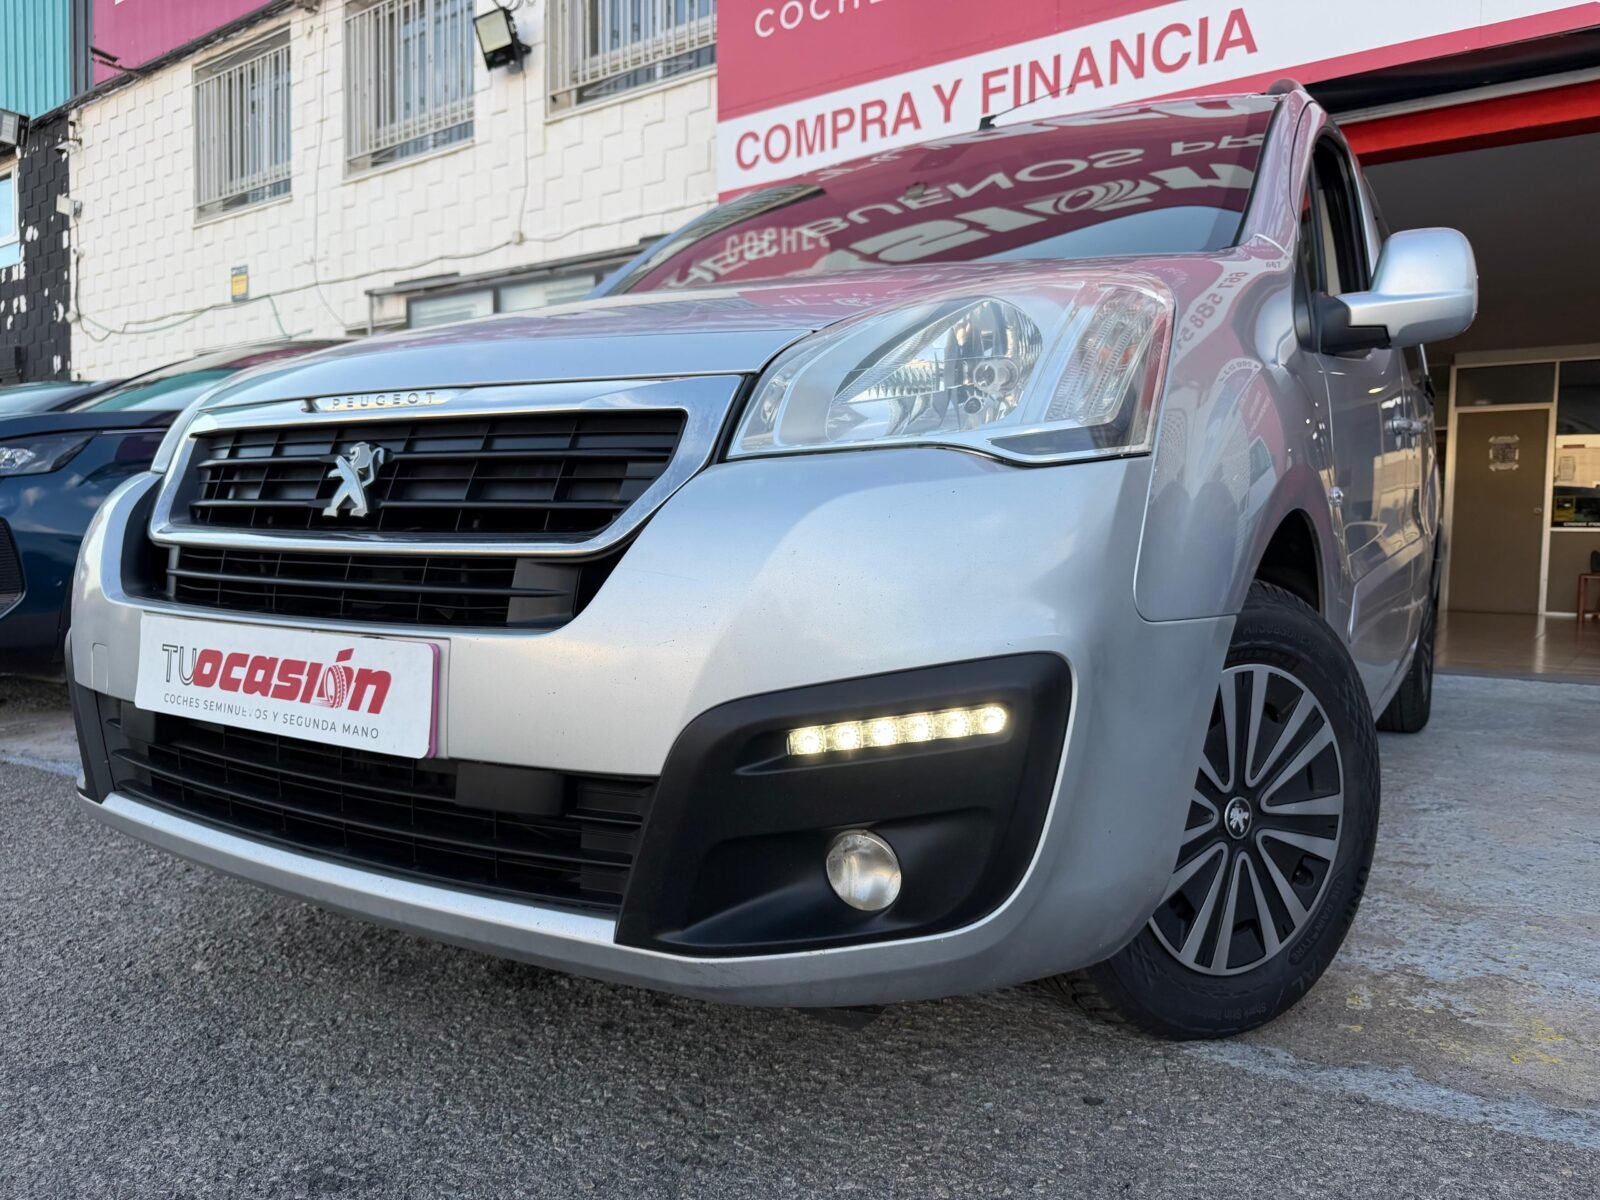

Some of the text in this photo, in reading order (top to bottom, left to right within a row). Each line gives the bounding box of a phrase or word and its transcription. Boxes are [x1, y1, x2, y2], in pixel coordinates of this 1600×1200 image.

[754, 0, 882, 38] COC
[735, 91, 921, 170] COMPRA
[933, 79, 962, 123] Y
[981, 8, 1258, 114] FINANCIA
[332, 391, 436, 409] PEUGEOT
[163, 692, 379, 740] COCHES SEMINUEOS Y SEGUNDA MANO
